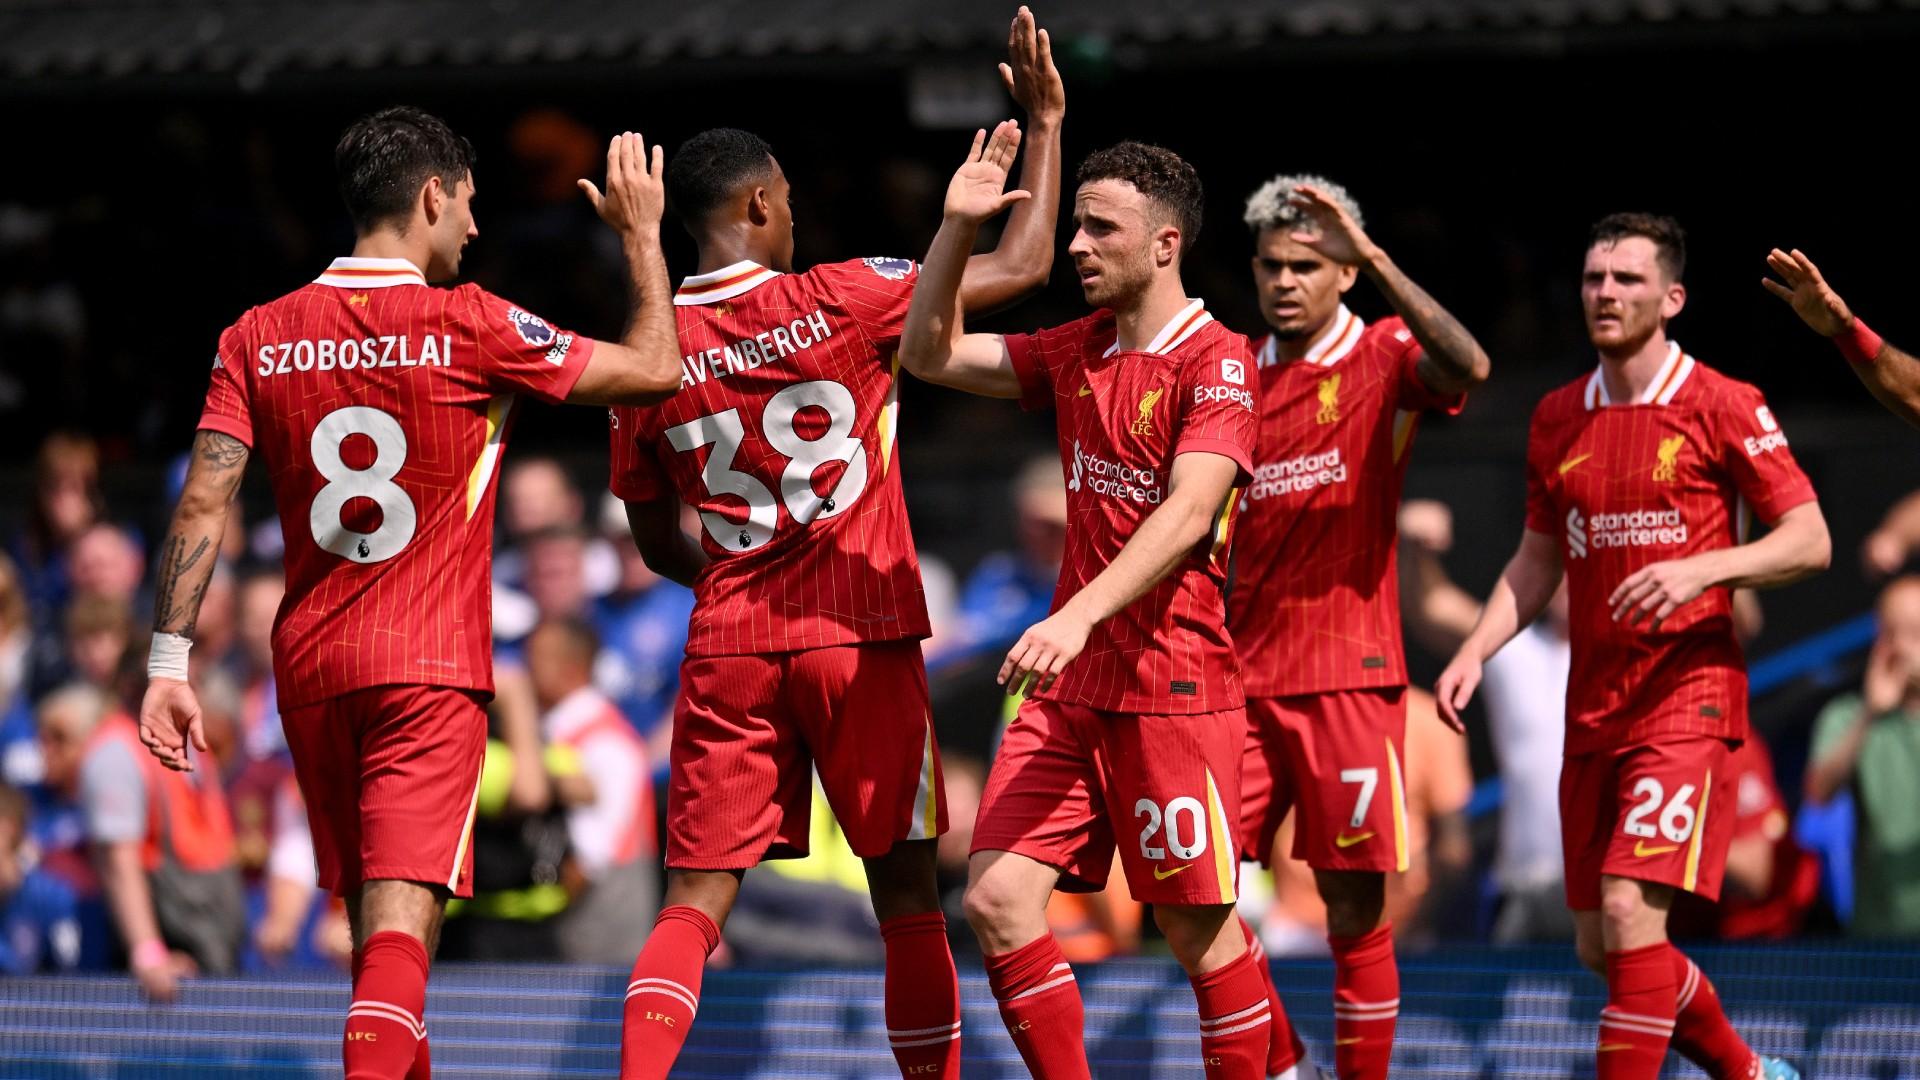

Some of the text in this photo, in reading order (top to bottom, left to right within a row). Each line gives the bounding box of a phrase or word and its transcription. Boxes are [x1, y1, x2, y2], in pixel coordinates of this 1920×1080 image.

[257, 334, 452, 378] SZOBOSZLAI
[679, 309, 833, 390] AVENBERCH
[663, 379, 868, 553] 38
[1083, 454, 1155, 486] standard
[1250, 463, 1347, 500] chartered
[1252, 447, 1340, 483] standard
[310, 405, 417, 565] 8
[1087, 473, 1161, 504] hartered
[1590, 508, 1680, 531] standard
[1591, 526, 1687, 549] chartered
[1340, 767, 1379, 829] 7
[1624, 776, 1696, 843] 26
[1134, 796, 1207, 860] 20
[347, 1031, 377, 1042] LFC
[646, 1011, 676, 1028] LFC
[908, 1063, 938, 1075] LFC
